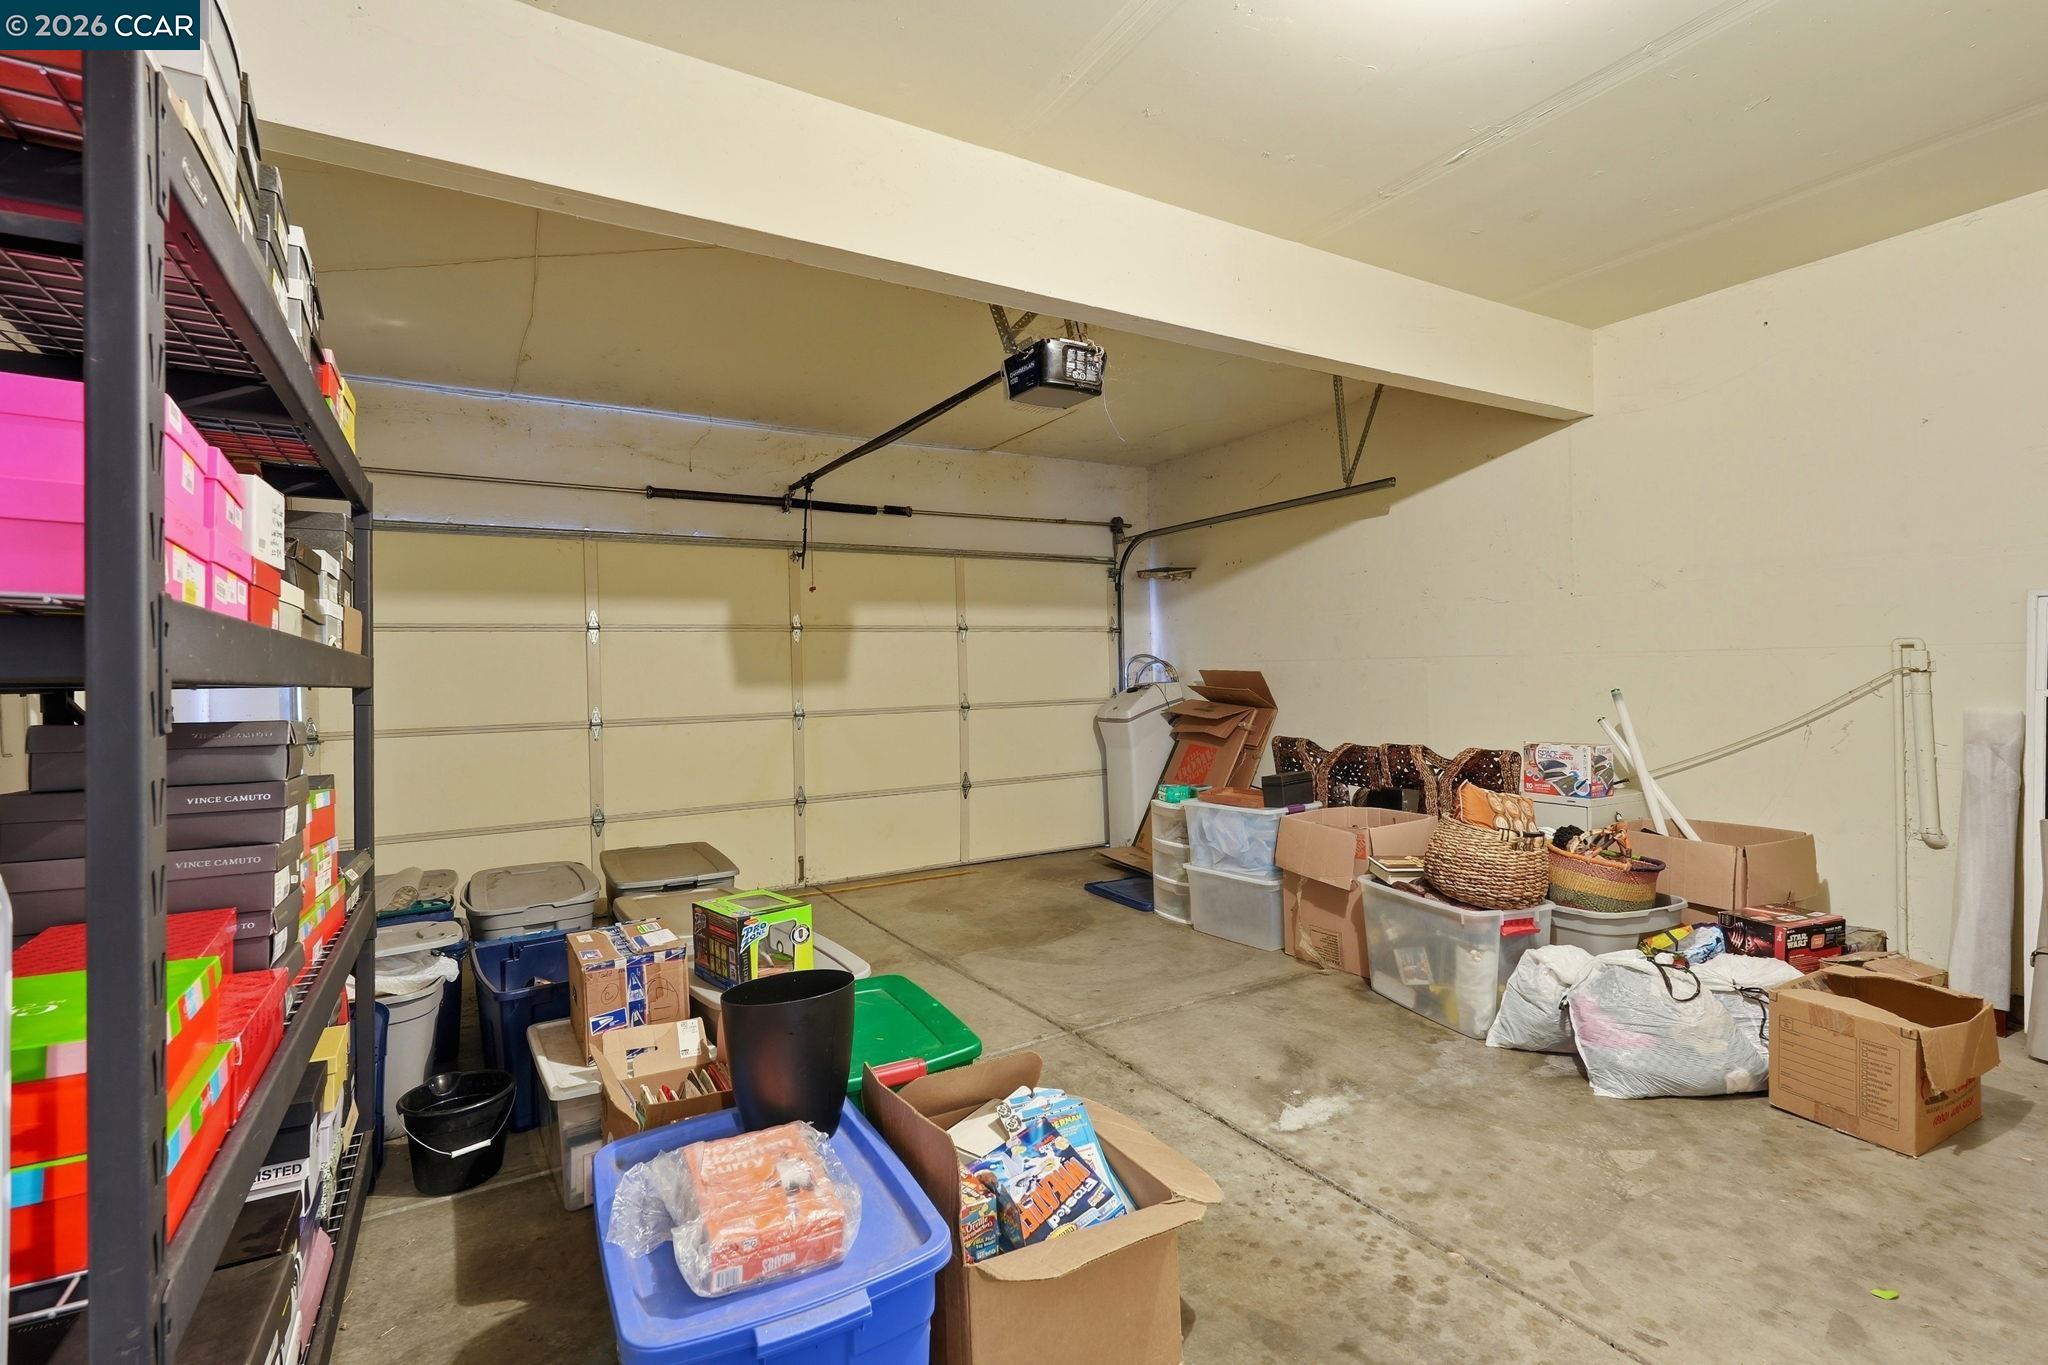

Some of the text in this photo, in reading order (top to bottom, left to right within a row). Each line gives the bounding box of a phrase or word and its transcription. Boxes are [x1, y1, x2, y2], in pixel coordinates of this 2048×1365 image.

[187, 793, 271, 805] VINCE CAMUTO
[176, 856, 261, 869] VINCE CAMUTO
[743, 922, 767, 938] PRO
[1787, 933, 1808, 942] STAR
[1787, 940, 1808, 949] WARS
[1051, 1113, 1081, 1129] ERMAN
[255, 1163, 302, 1182] ISTED
[1020, 1156, 1091, 1239] WHEATIE
[1050, 1177, 1098, 1229] Frosted
